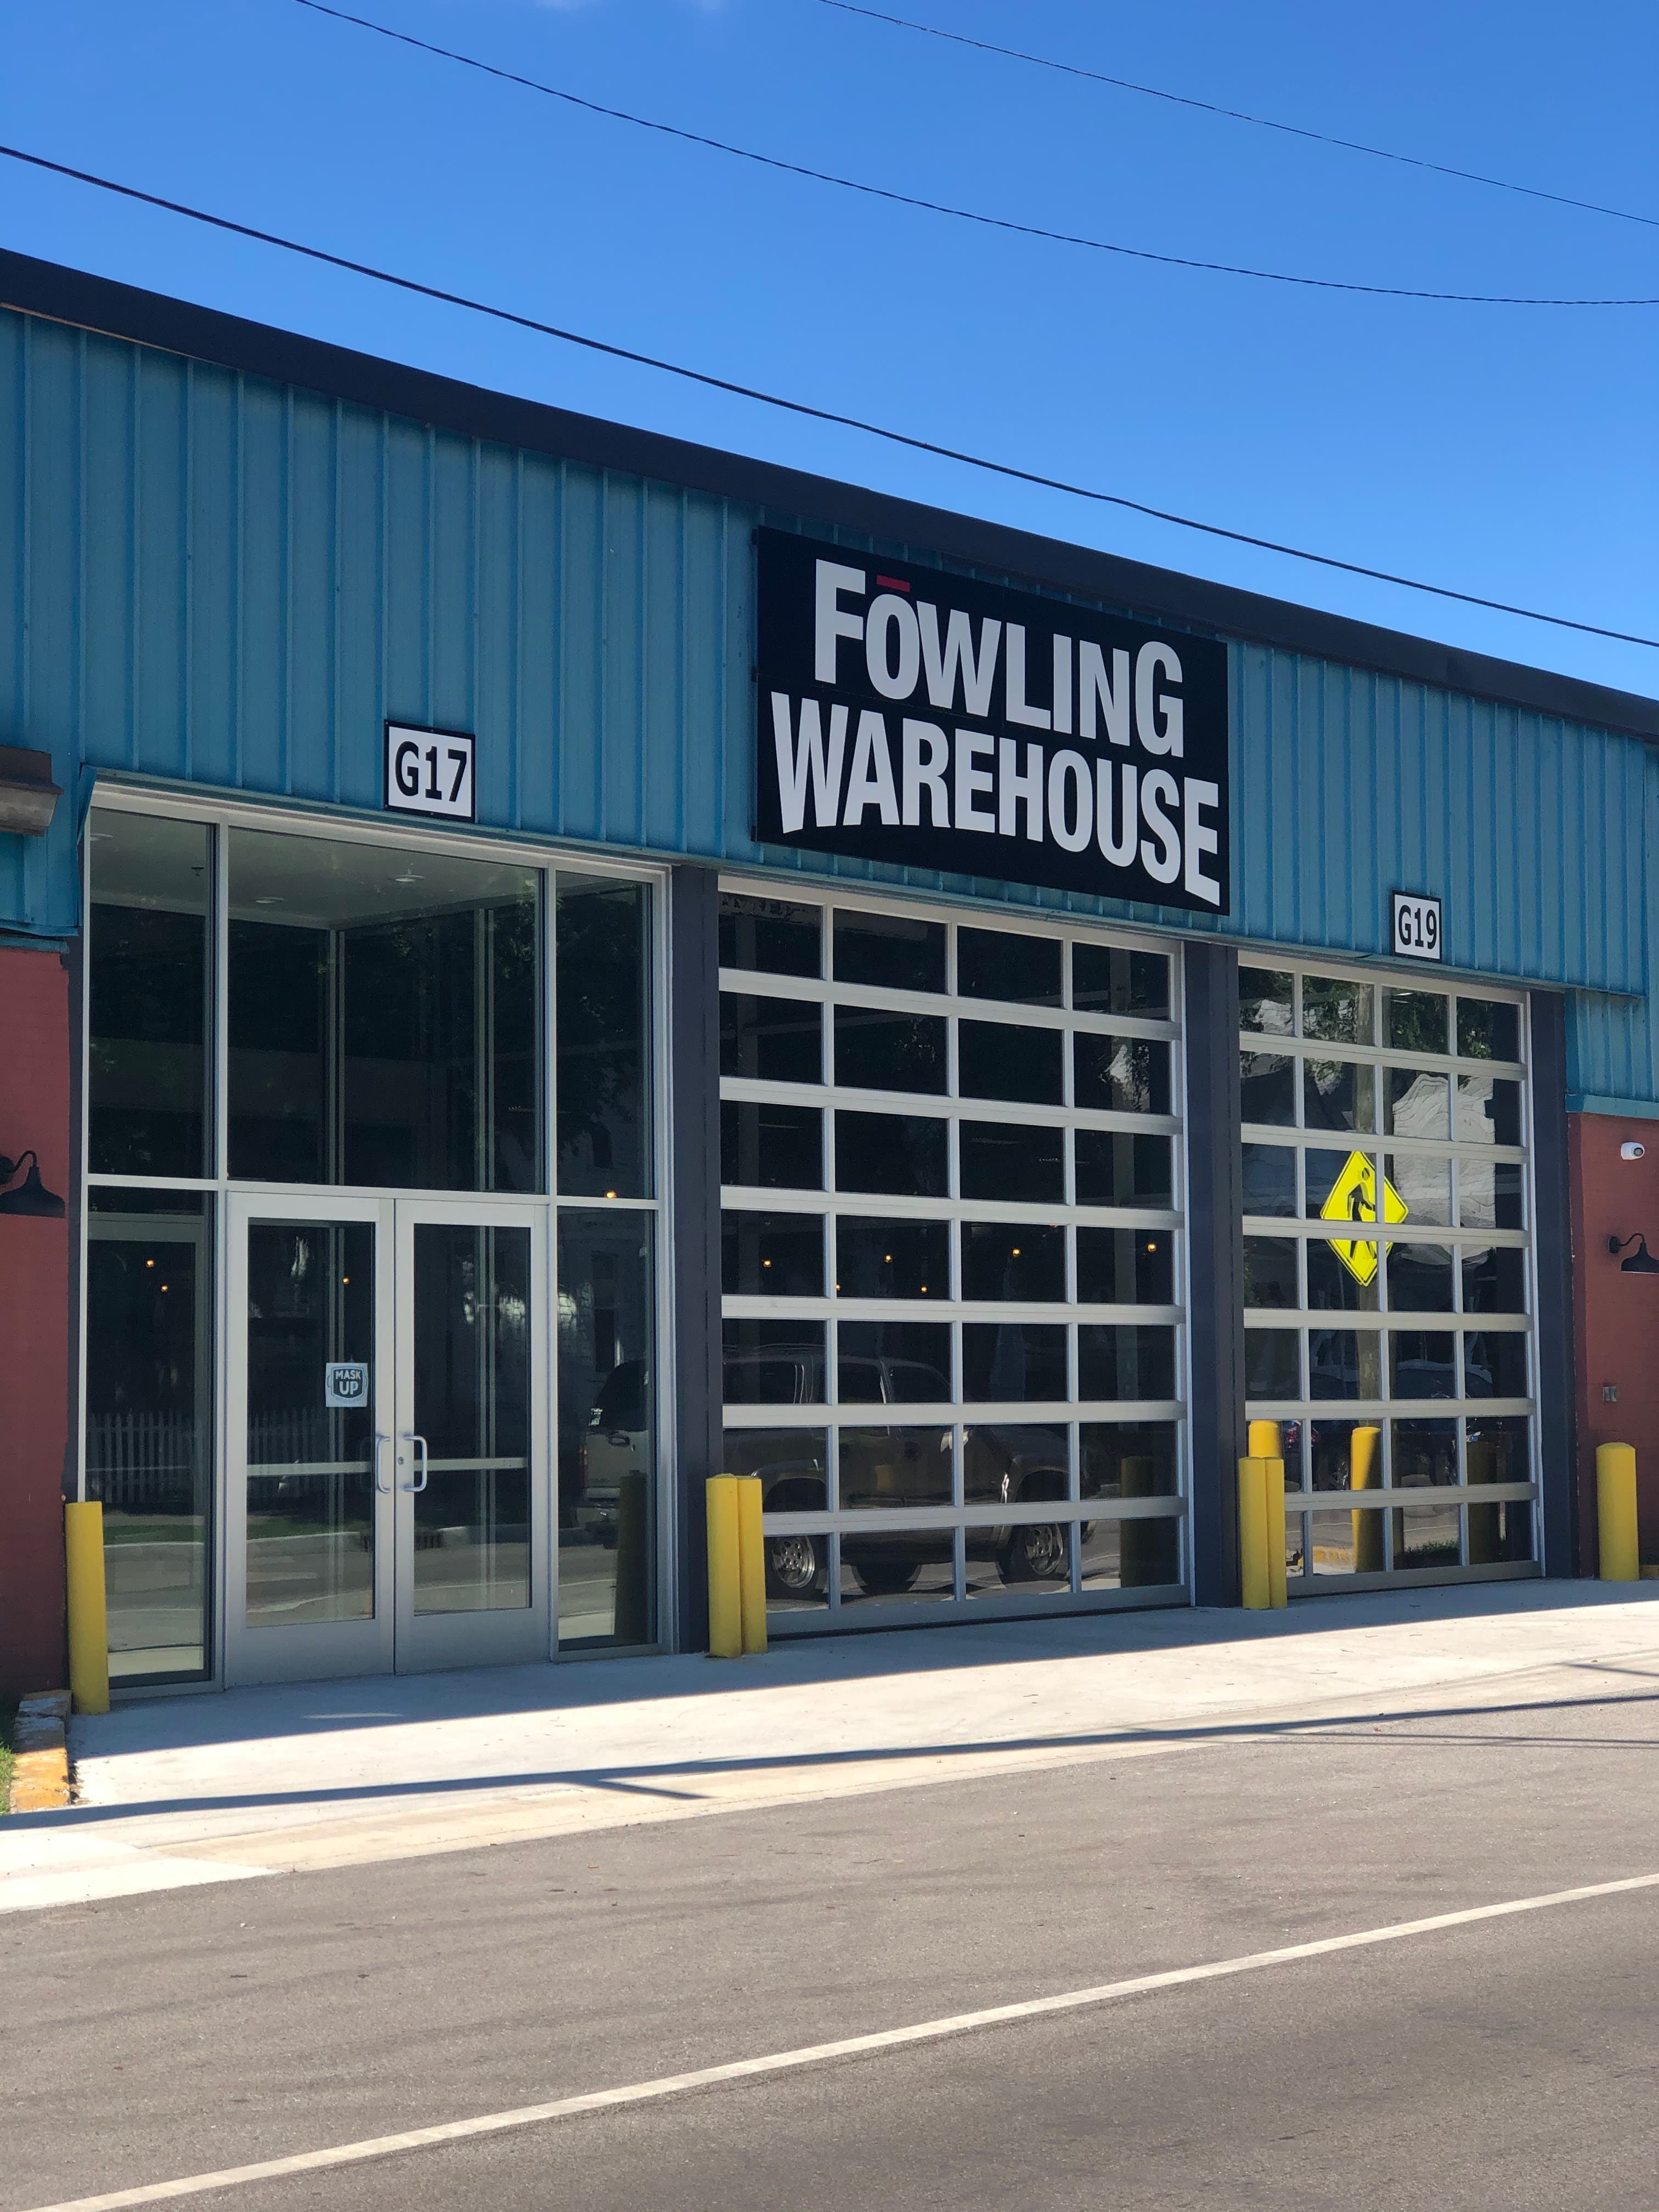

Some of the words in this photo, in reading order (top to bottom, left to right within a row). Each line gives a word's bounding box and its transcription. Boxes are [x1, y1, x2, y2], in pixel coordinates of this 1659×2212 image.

[395, 741, 467, 802] G17
[771, 691, 1220, 906] WAREHOUSE
[1398, 905, 1437, 950] G19
[335, 1370, 361, 1380] MASK
[339, 1381, 359, 1395] UP
